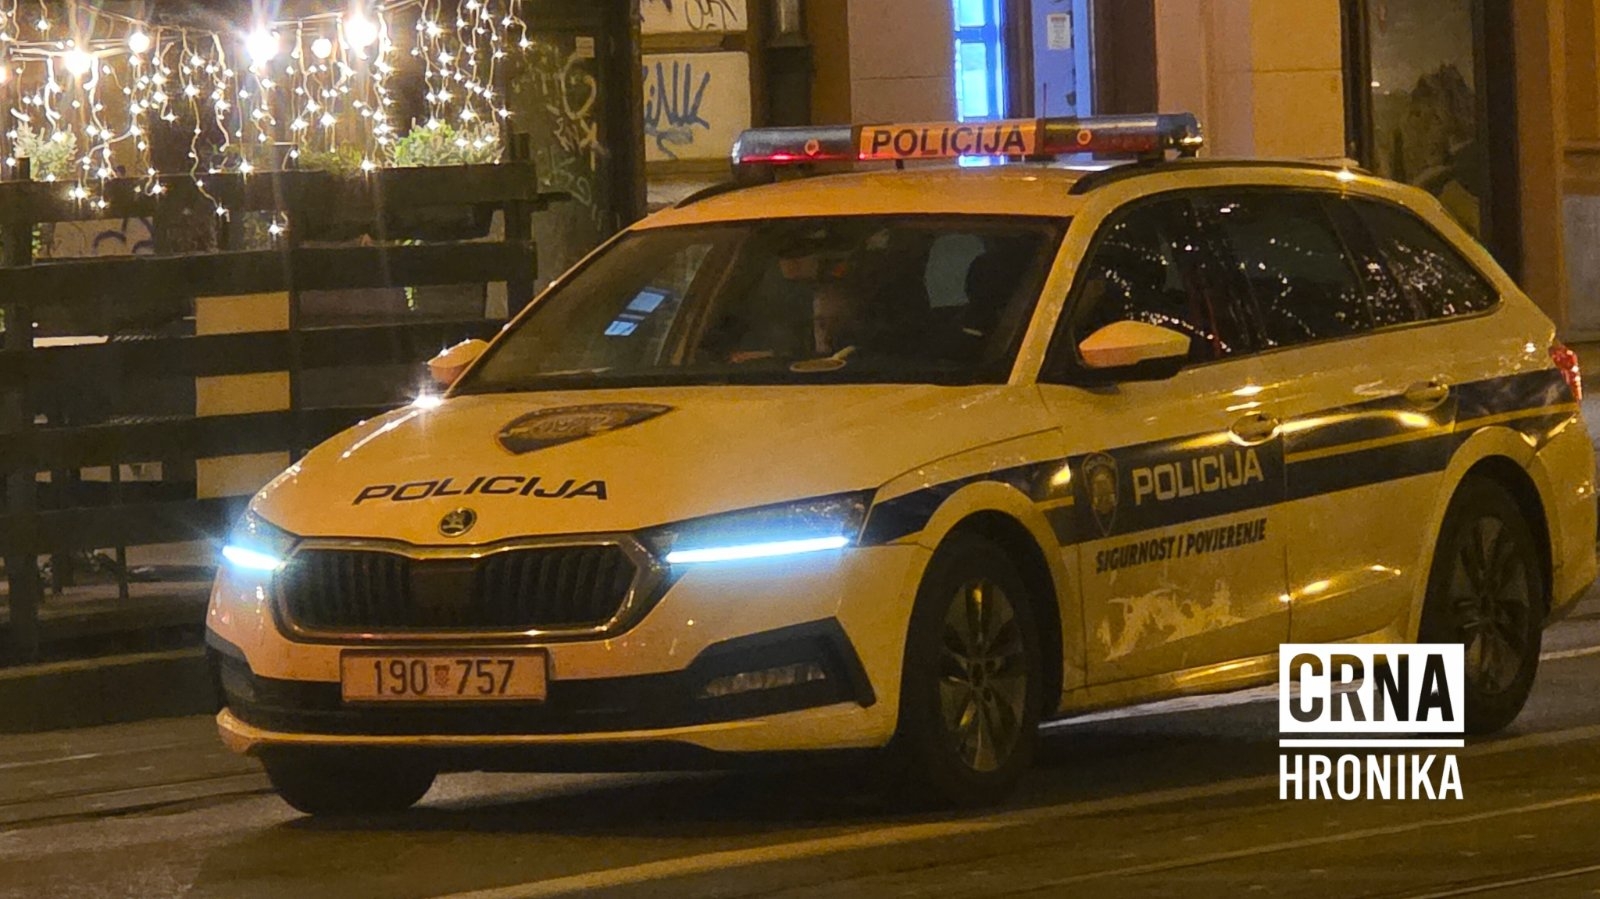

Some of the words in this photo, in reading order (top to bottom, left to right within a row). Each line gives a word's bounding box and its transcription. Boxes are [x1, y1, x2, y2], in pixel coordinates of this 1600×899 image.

[871, 125, 1027, 156] POLICIJA
[352, 476, 607, 505] POLICIJA
[1132, 449, 1264, 505] POLICIJA
[1096, 536, 1175, 574] SIGURNOST
[1177, 535, 1184, 558] I
[1185, 517, 1267, 557] POVJERENJE
[374, 660, 428, 695] 190
[455, 659, 515, 695] 757
